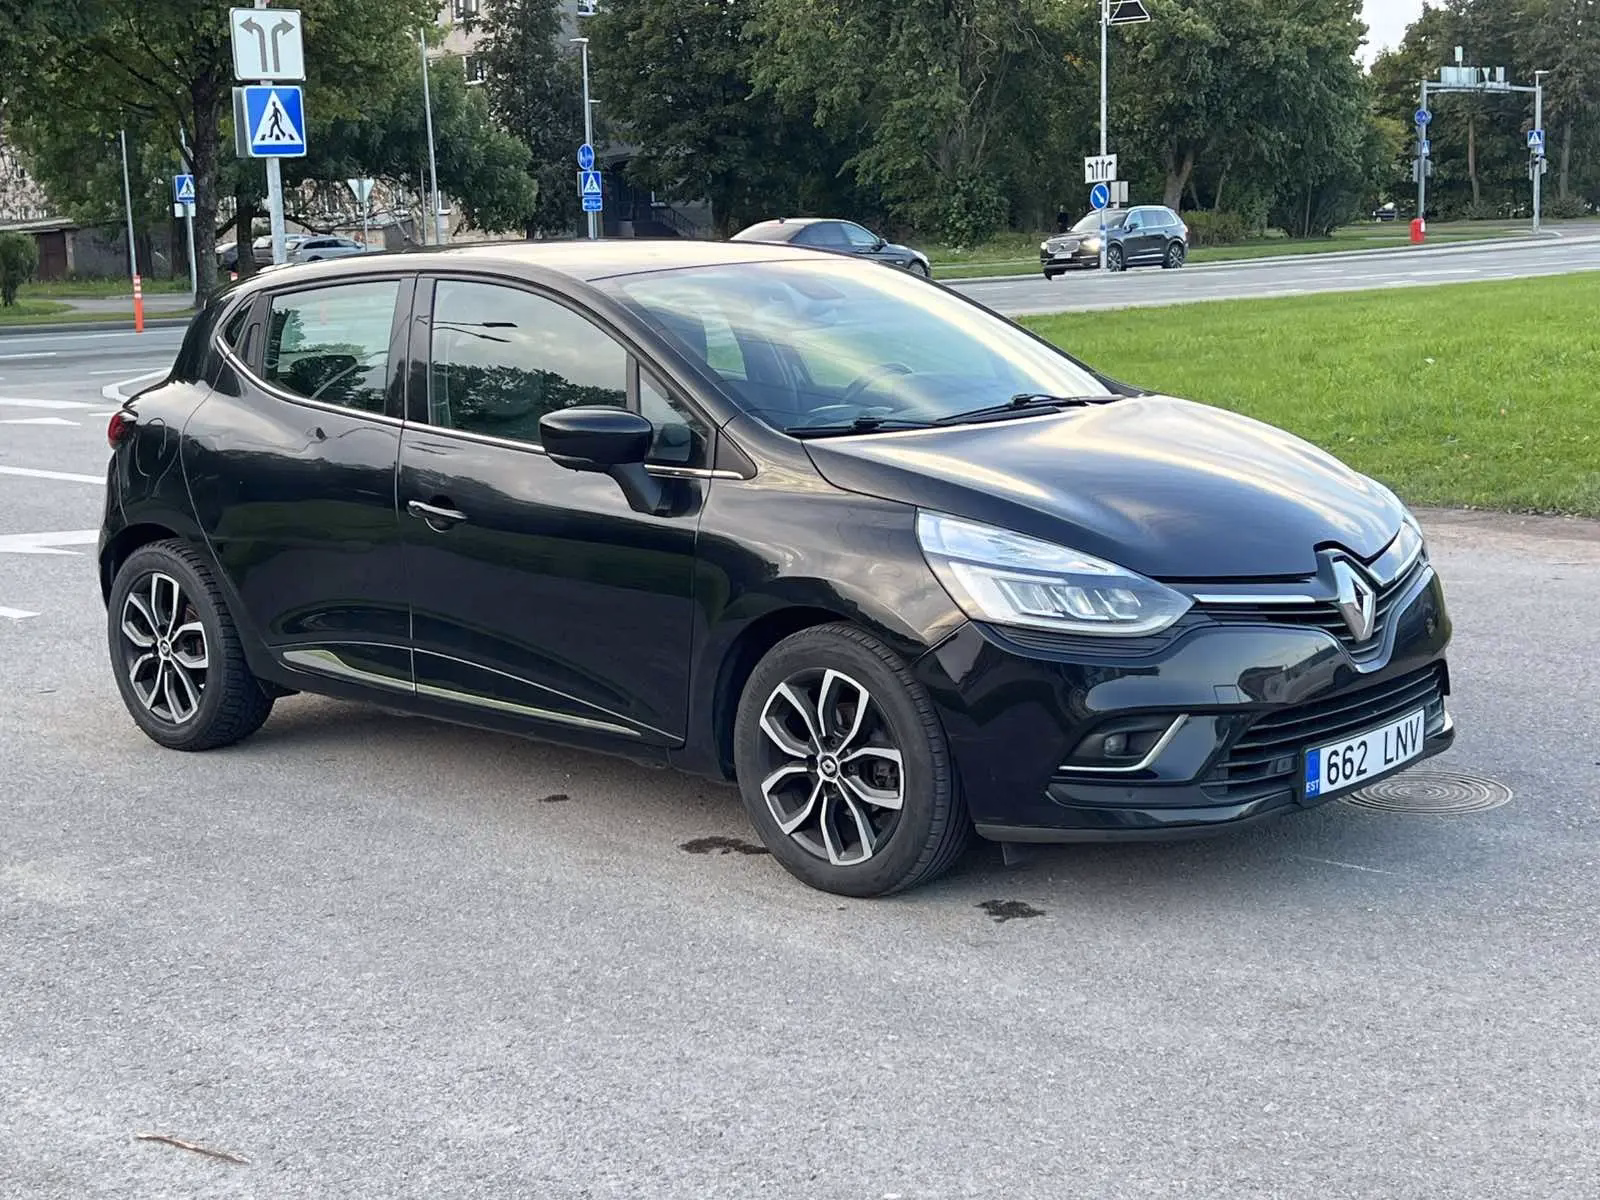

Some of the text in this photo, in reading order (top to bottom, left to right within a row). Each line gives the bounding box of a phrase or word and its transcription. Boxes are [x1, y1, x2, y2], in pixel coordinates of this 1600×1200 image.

[1327, 716, 1420, 785] 662 LNV
[1306, 780, 1319, 793] EST
